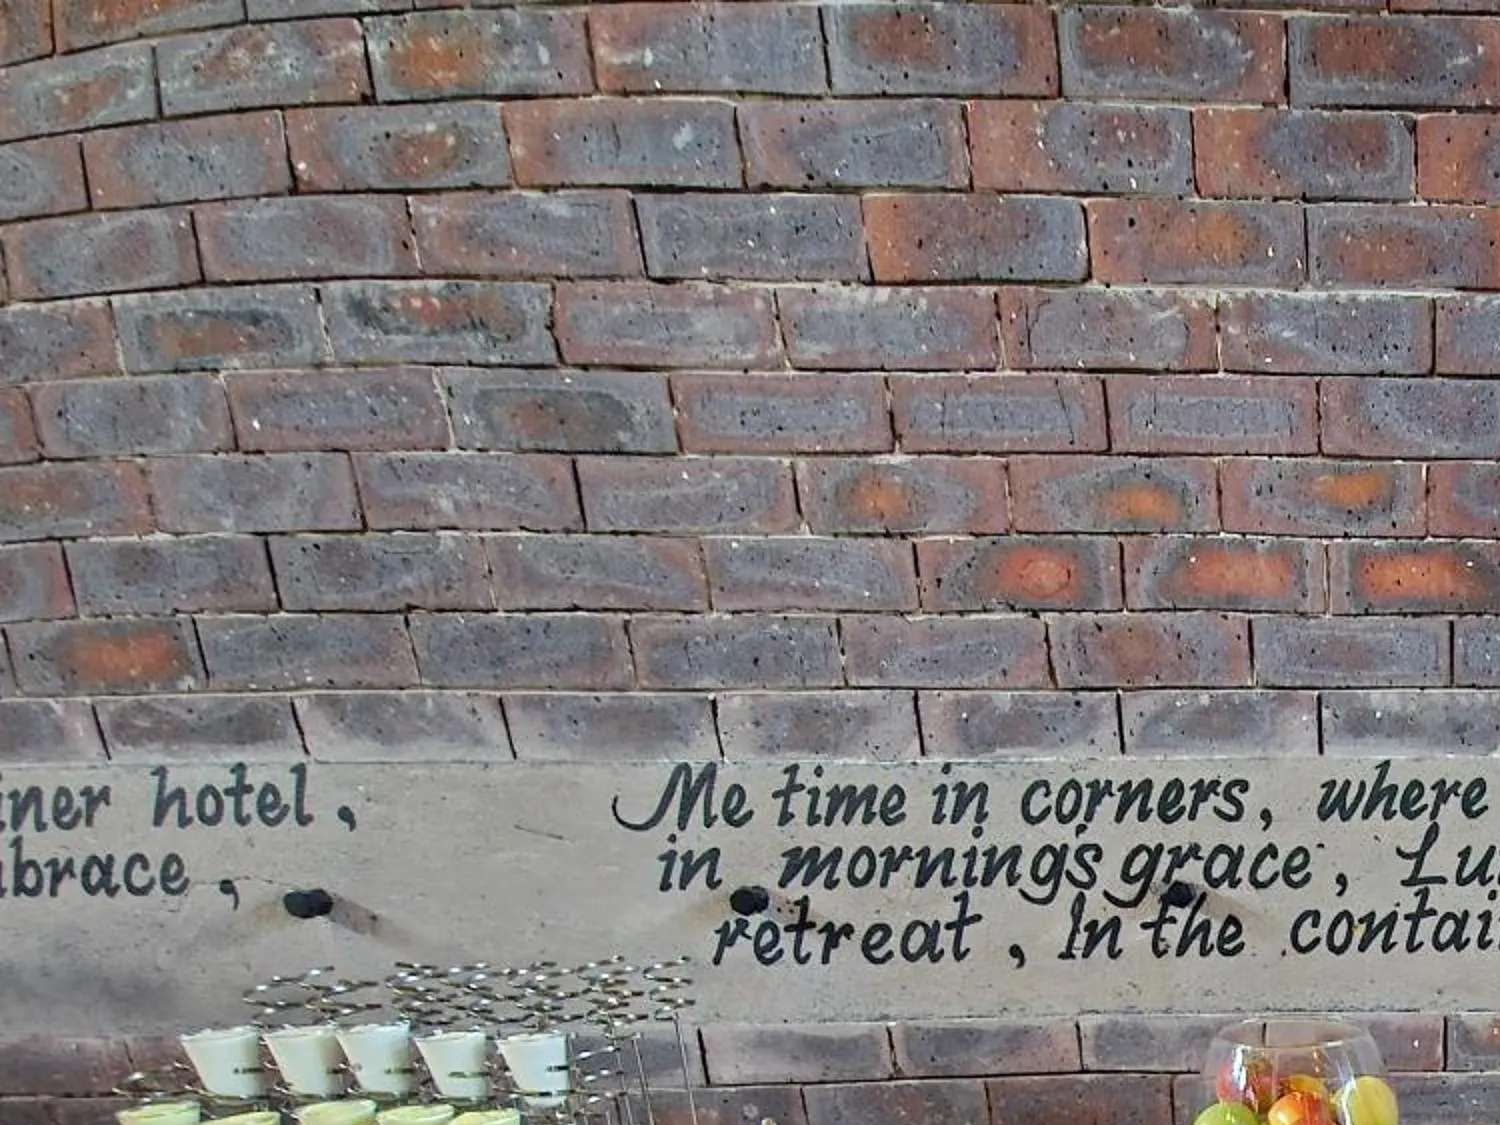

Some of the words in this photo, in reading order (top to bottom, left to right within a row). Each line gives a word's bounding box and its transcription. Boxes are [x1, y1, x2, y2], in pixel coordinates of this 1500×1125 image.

[0, 772, 110, 832] ner
[611, 762, 754, 831] Me
[771, 764, 907, 827] time
[931, 769, 990, 825] in
[1020, 776, 1273, 834] corners,
[1316, 759, 1489, 823] where
[0, 834, 239, 911] brace,
[657, 833, 722, 892] in
[1139, 891, 1246, 959] the
